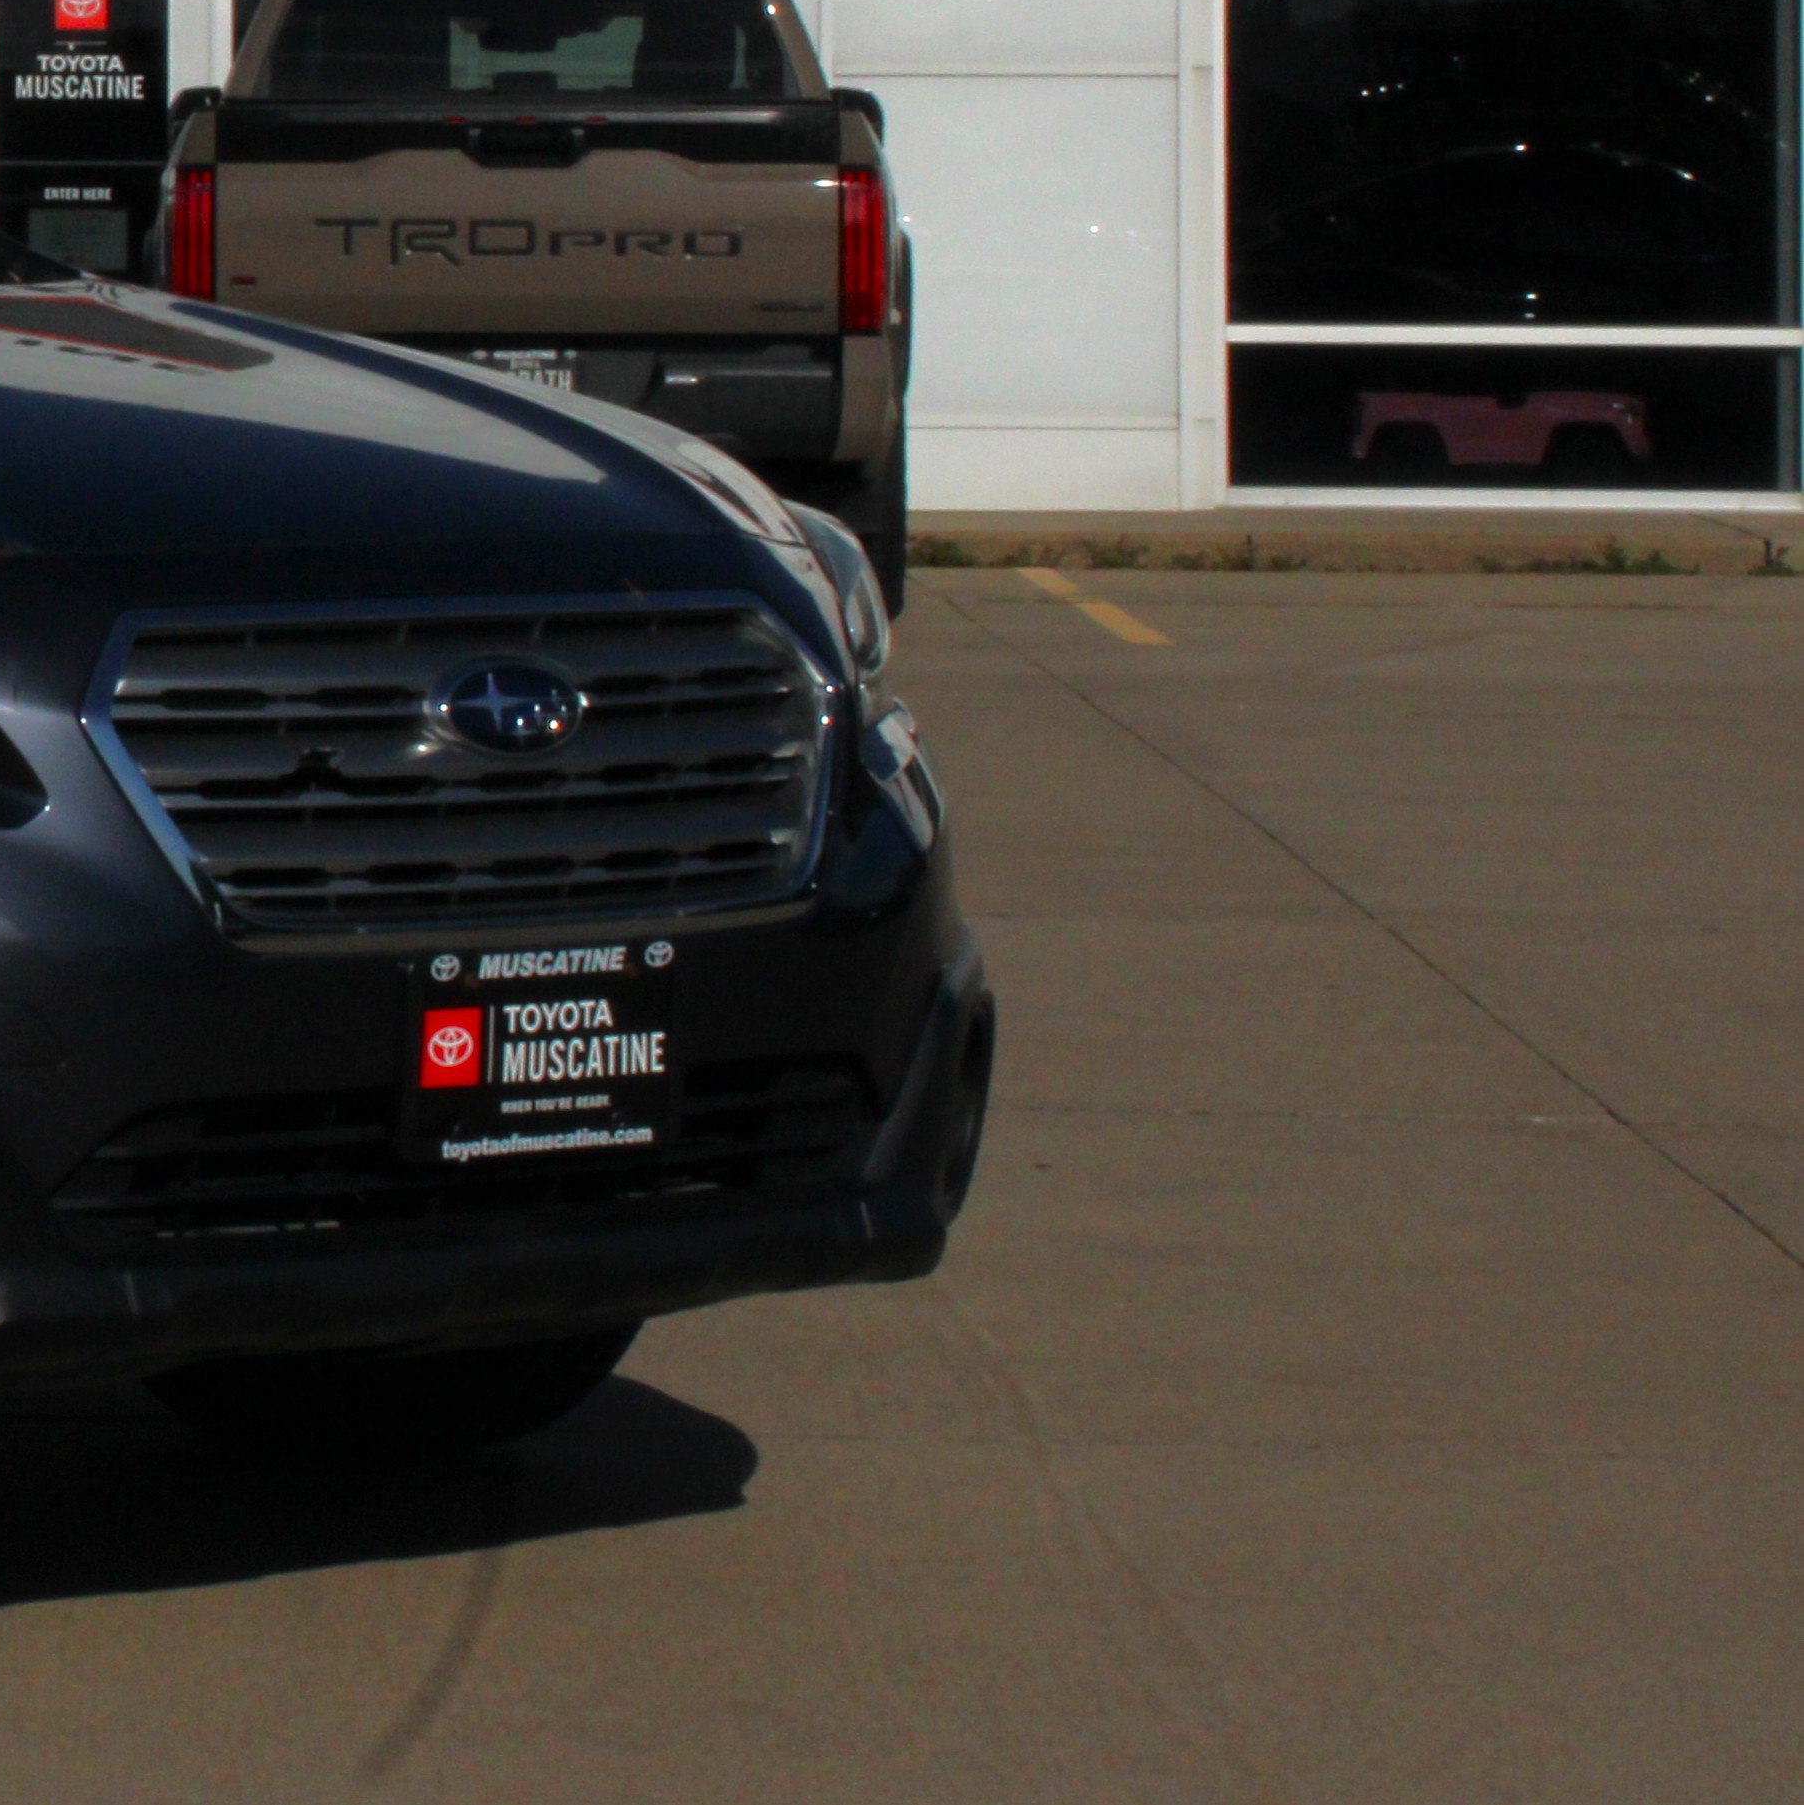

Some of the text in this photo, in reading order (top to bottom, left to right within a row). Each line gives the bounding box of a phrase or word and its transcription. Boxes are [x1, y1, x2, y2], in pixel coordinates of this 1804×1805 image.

[36, 55, 124, 72] TOYOTA
[15, 75, 144, 99] MUSCATINE
[44, 187, 112, 200] ENTER HERE
[478, 946, 627, 980] MUSCATINE
[502, 998, 614, 1034] TOYOTA
[502, 1031, 666, 1084] MUSCATINE
[442, 1126, 653, 1162] toyotaofmuscatine.com
